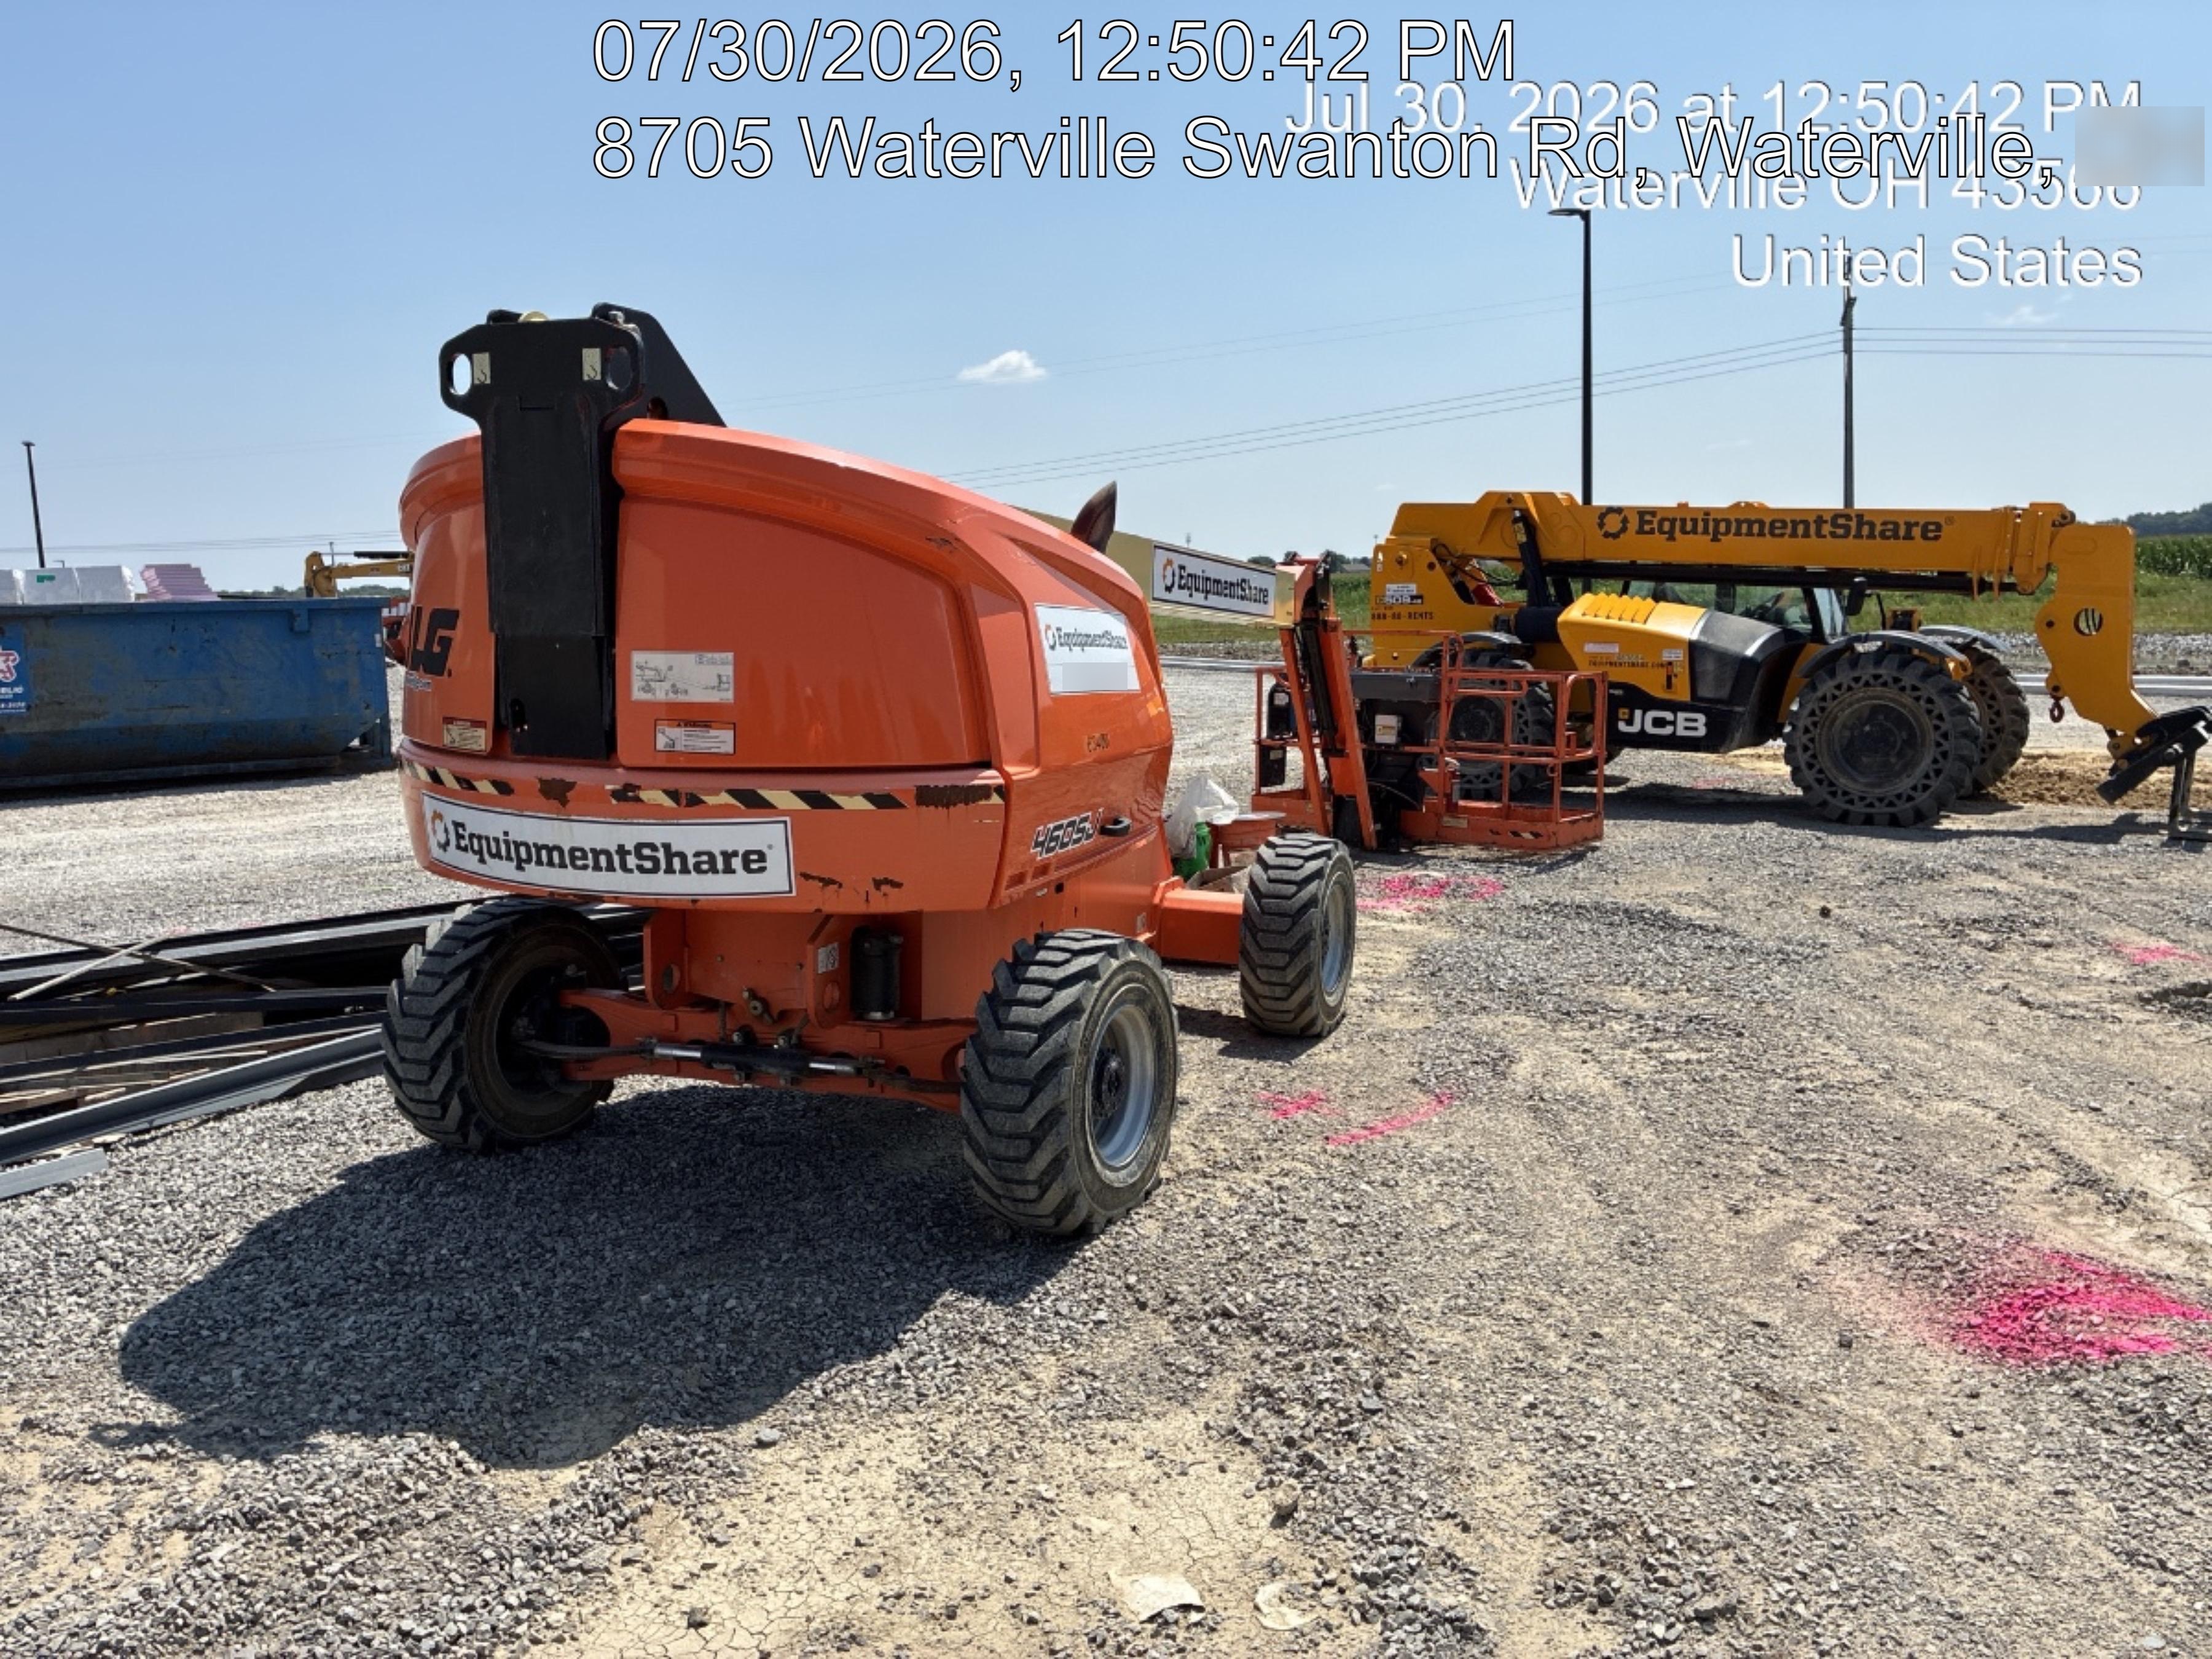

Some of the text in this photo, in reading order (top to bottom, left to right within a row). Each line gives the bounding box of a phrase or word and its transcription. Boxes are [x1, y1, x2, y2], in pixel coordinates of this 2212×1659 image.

[1635, 510, 1942, 542] EquipmentShare
[1177, 564, 1269, 604] EquipmentShare
[1618, 709, 1707, 737] JCB
[451, 820, 768, 875] EquipmentShare
